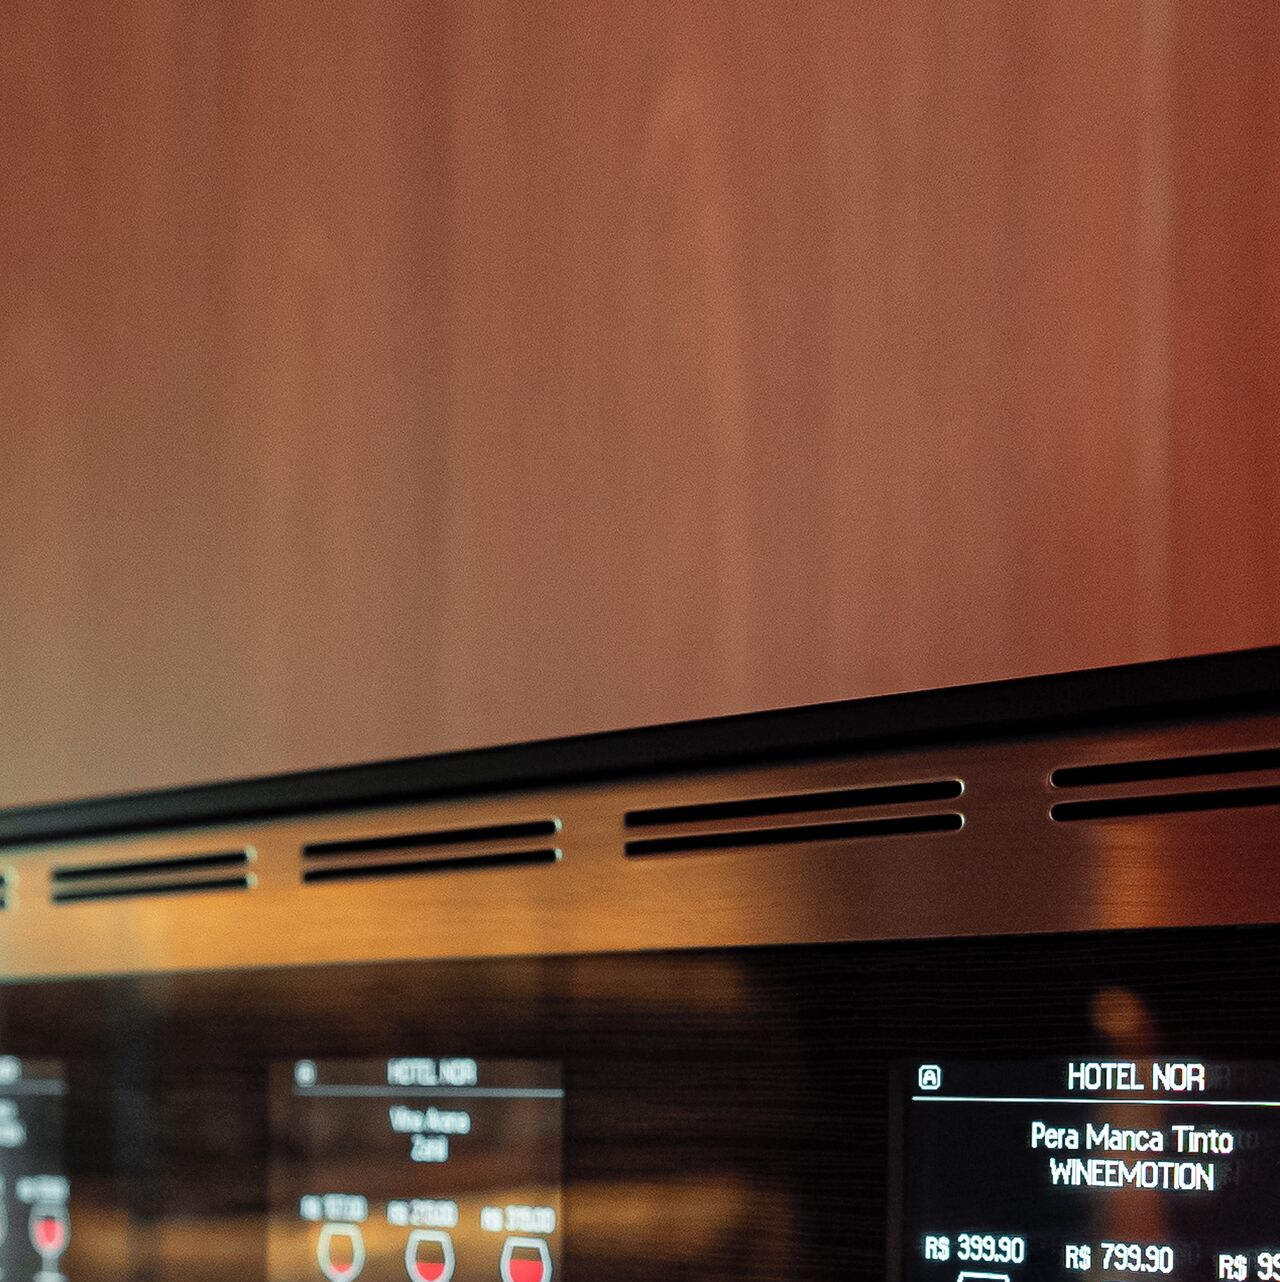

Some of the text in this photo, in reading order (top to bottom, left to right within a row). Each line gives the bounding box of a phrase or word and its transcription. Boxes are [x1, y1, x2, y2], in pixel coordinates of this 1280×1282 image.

[1068, 1063, 1205, 1091] HOTEL NOR
[1031, 1122, 1234, 1153] Pera Manca Tinto
[1050, 1158, 1214, 1190] WINEEMOTION
[925, 1234, 1025, 1263] R$ 399.90
[1065, 1243, 1174, 1274] R$ 799.90
[1219, 1255, 1248, 1281] R$
